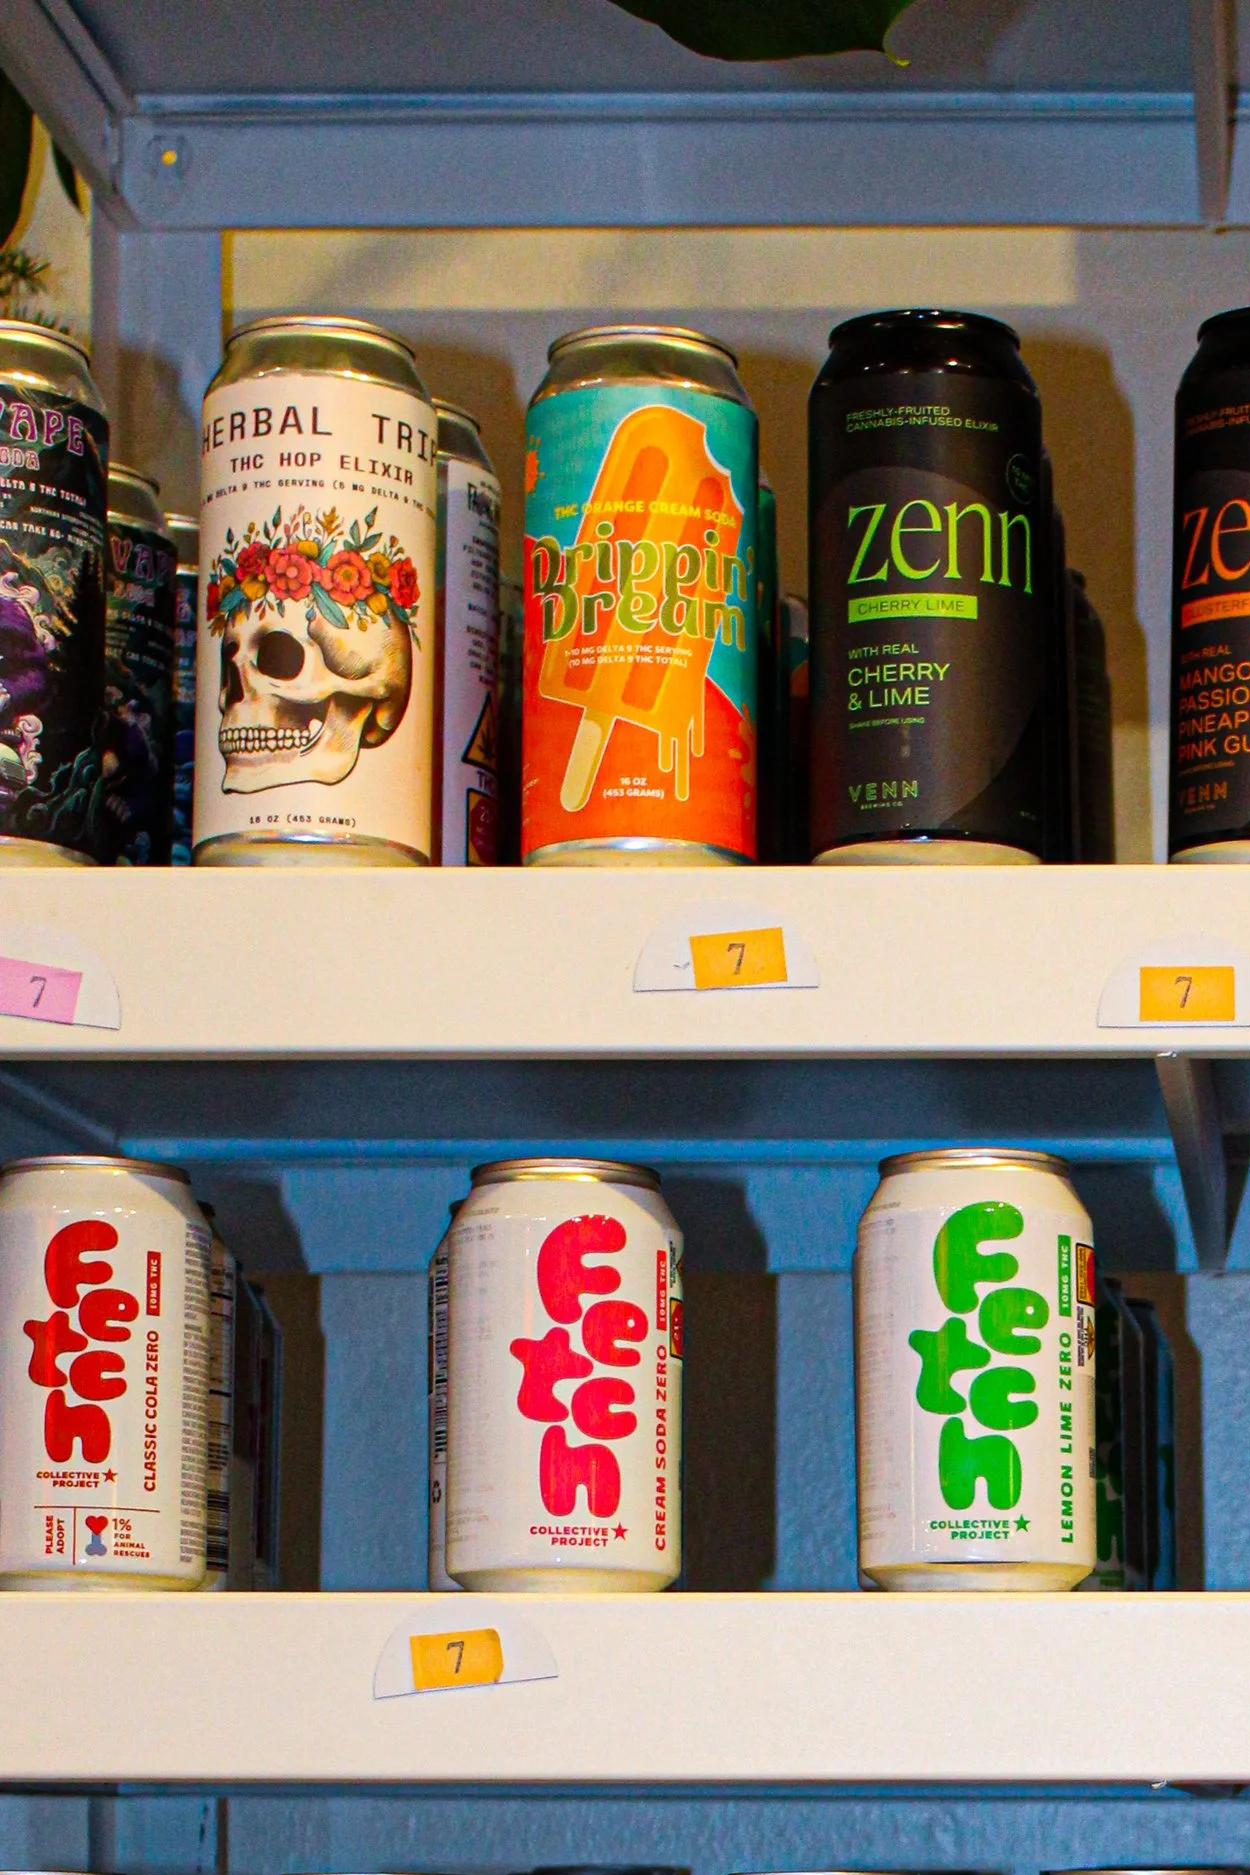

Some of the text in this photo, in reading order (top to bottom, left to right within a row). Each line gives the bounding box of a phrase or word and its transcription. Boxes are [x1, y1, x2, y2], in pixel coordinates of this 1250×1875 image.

[0, 399, 83, 456] APE
[229, 453, 413, 486] THC HOP ELIXIR
[554, 501, 737, 528] THC ORANGE CREAM SODA
[847, 499, 1033, 594] zenn
[534, 585, 746, 652] Dream
[857, 600, 965, 615] CHERRY LIME
[847, 663, 951, 686] CHERRY
[848, 687, 930, 711] & LIME
[726, 942, 748, 977] 7
[28, 976, 48, 1009] 7
[1173, 975, 1192, 1010] 7
[144, 1330, 159, 1492] CLASSIC COLA ZERO
[655, 1344, 667, 1551] CREAM SODA ZERO
[1059, 1331, 1074, 1544] LEMON LIME ZERO
[36, 1471, 99, 1479] COLLECTIVE
[52, 1480, 99, 1488] PROJECT
[529, 1526, 608, 1537] COLLECTIVE
[930, 1520, 1009, 1529] COLLECTIVE
[951, 1530, 1009, 1540] PROJECT
[551, 1537, 608, 1547] PROJECT
[447, 1640, 464, 1674] 7
